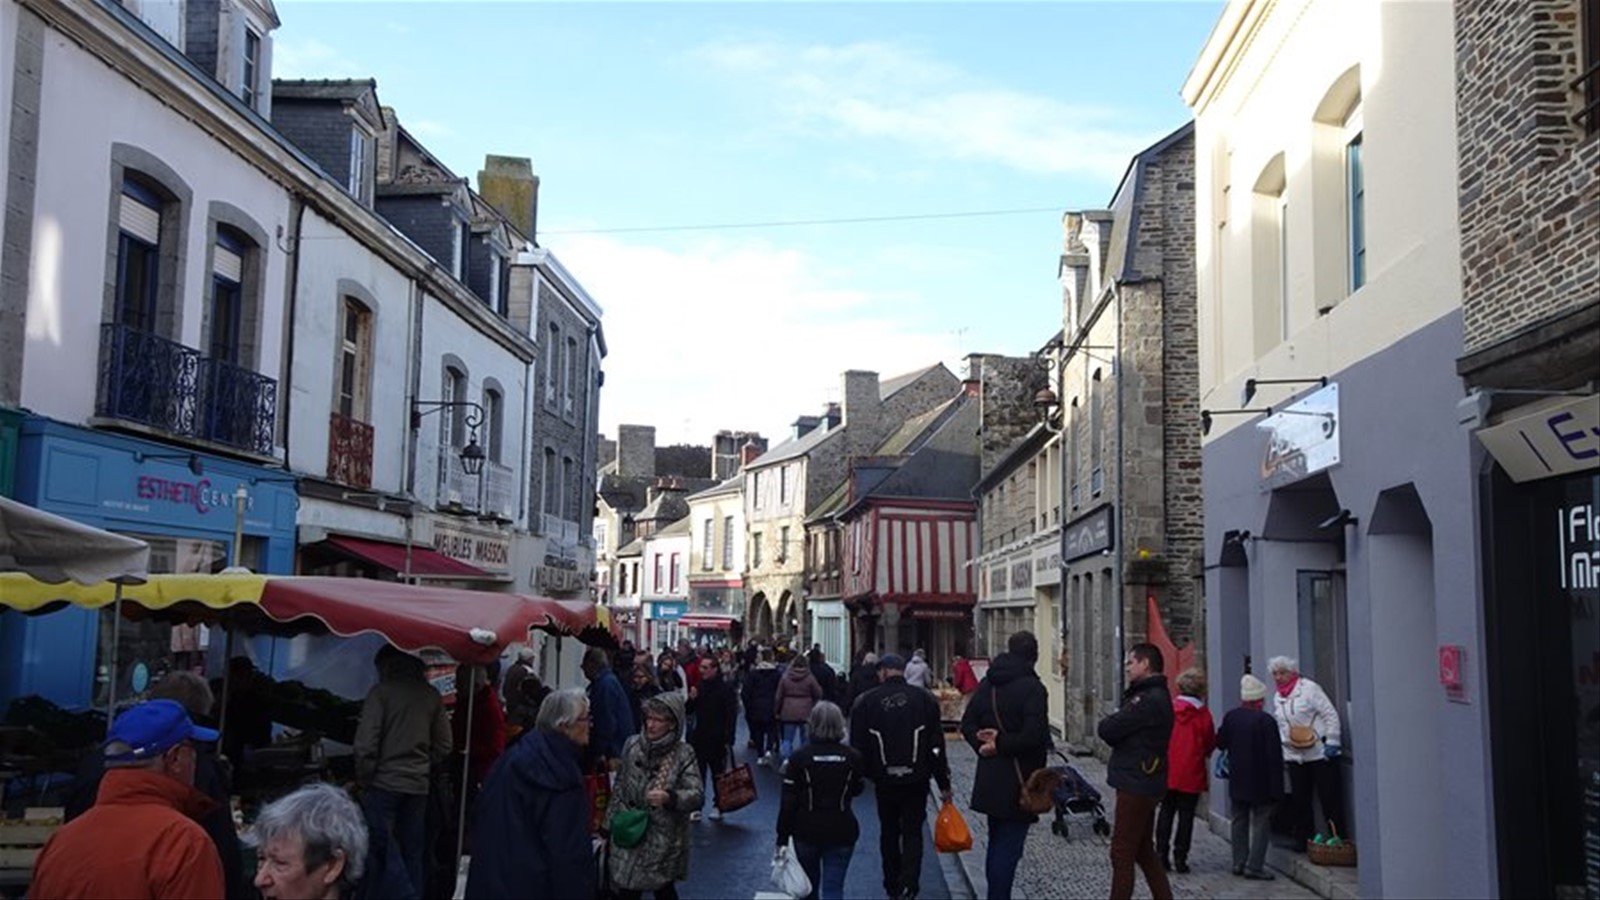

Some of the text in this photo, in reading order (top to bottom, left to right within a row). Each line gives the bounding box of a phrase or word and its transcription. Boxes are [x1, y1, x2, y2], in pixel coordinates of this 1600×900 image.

[1548, 412, 1600, 460] E
[200, 488, 254, 511] CENTR
[434, 533, 509, 564] MEUBLES MASSON
